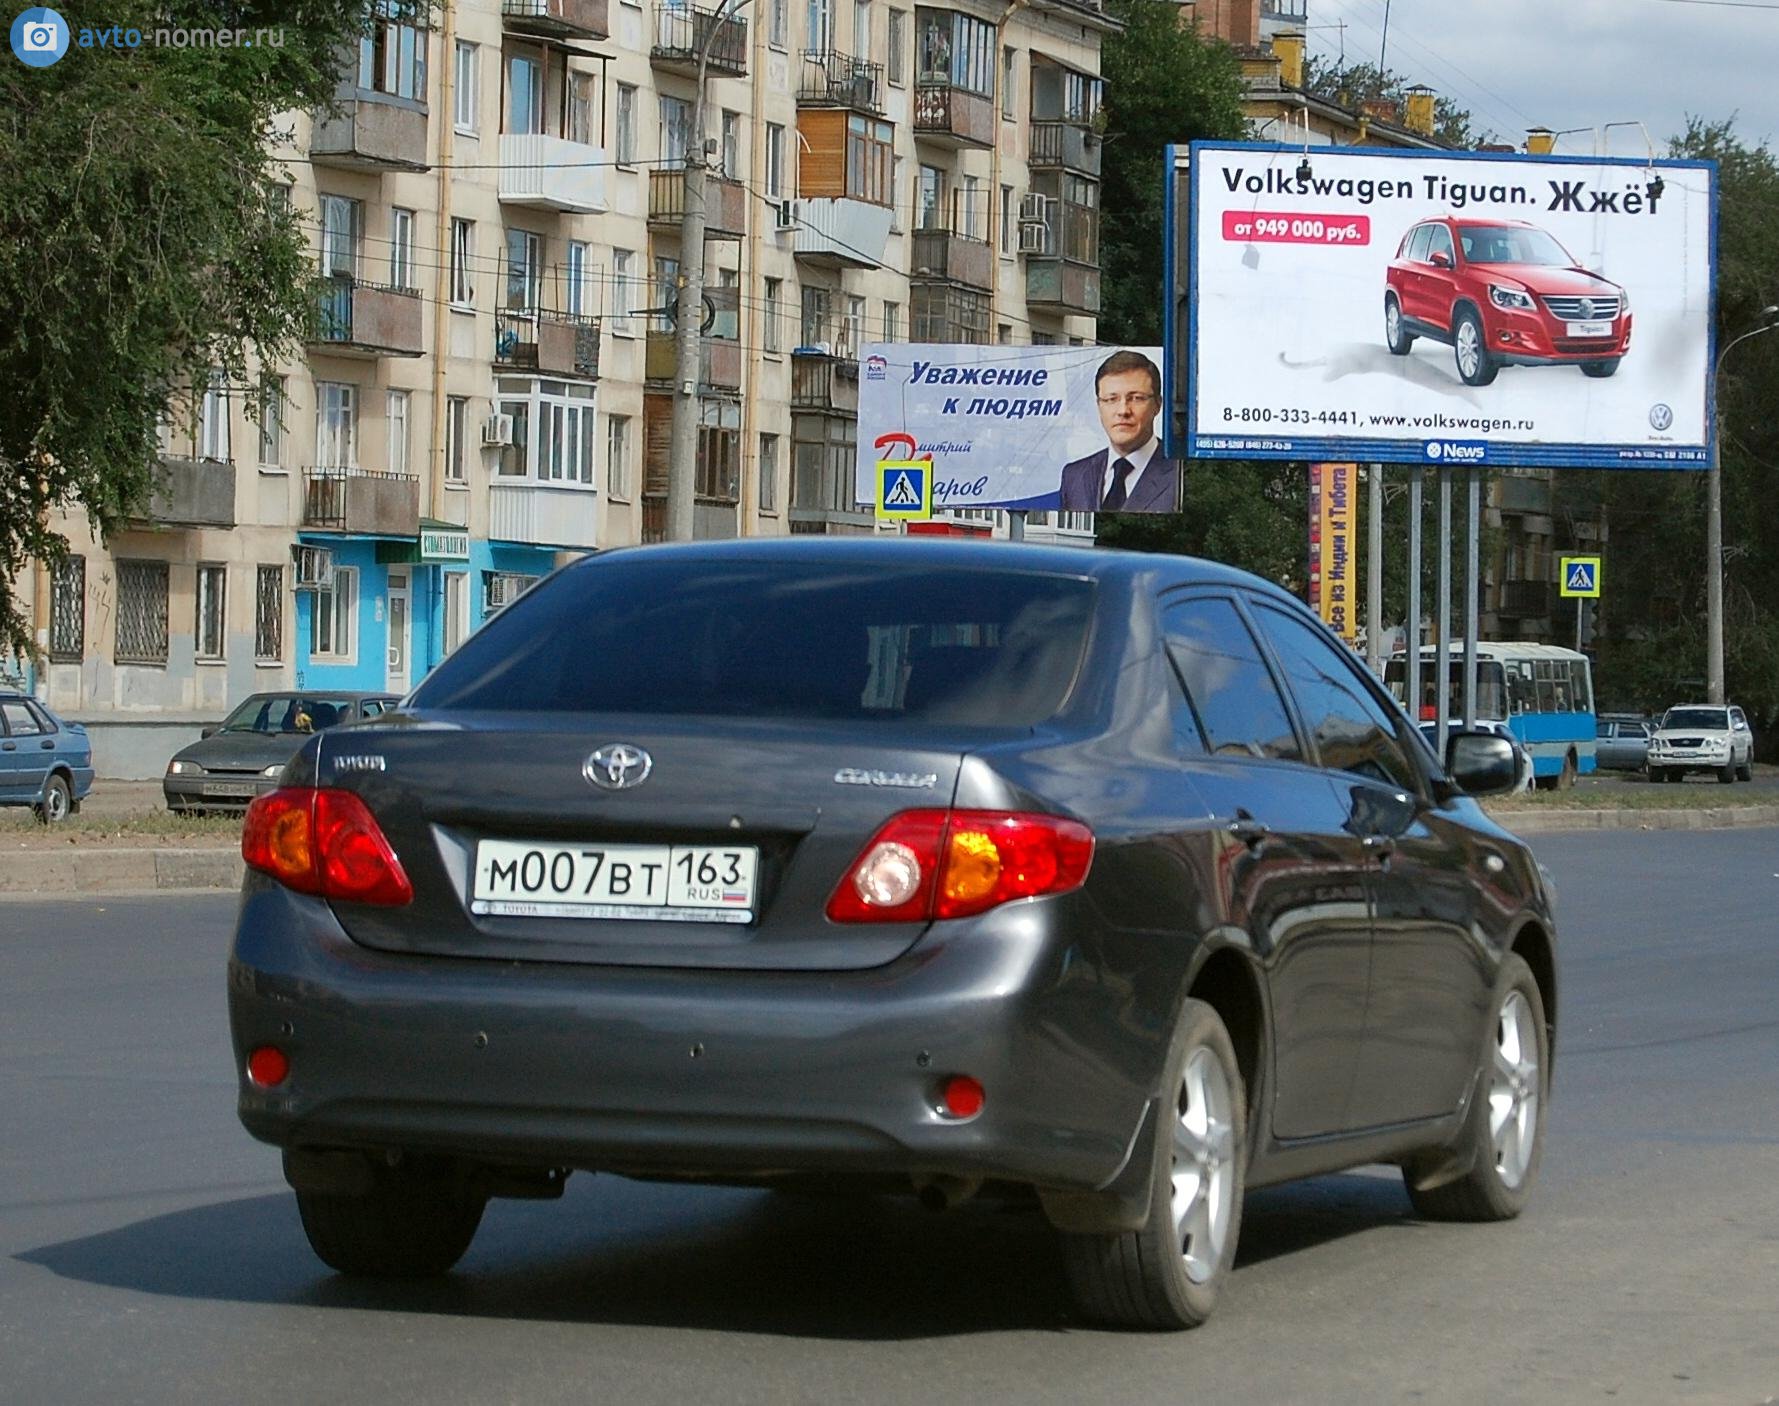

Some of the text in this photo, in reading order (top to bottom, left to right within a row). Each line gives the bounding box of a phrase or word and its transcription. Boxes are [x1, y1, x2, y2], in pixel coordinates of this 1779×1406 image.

[1222, 167, 1536, 208] Volkswagen Tiguan.
[1234, 219, 1361, 241] от 949 000 руб.
[909, 361, 1049, 386] Уважение
[942, 398, 1063, 419] к людям
[1223, 407, 1534, 432] 8-800-333-4441, www.volkswagen.ru
[1443, 443, 1485, 458] News
[932, 475, 989, 502] аров
[1328, 467, 1347, 518] Тибета
[1328, 534, 1348, 581] Индии
[1331, 584, 1345, 602] из
[677, 853, 741, 885] 163
[688, 887, 720, 900] RUS
